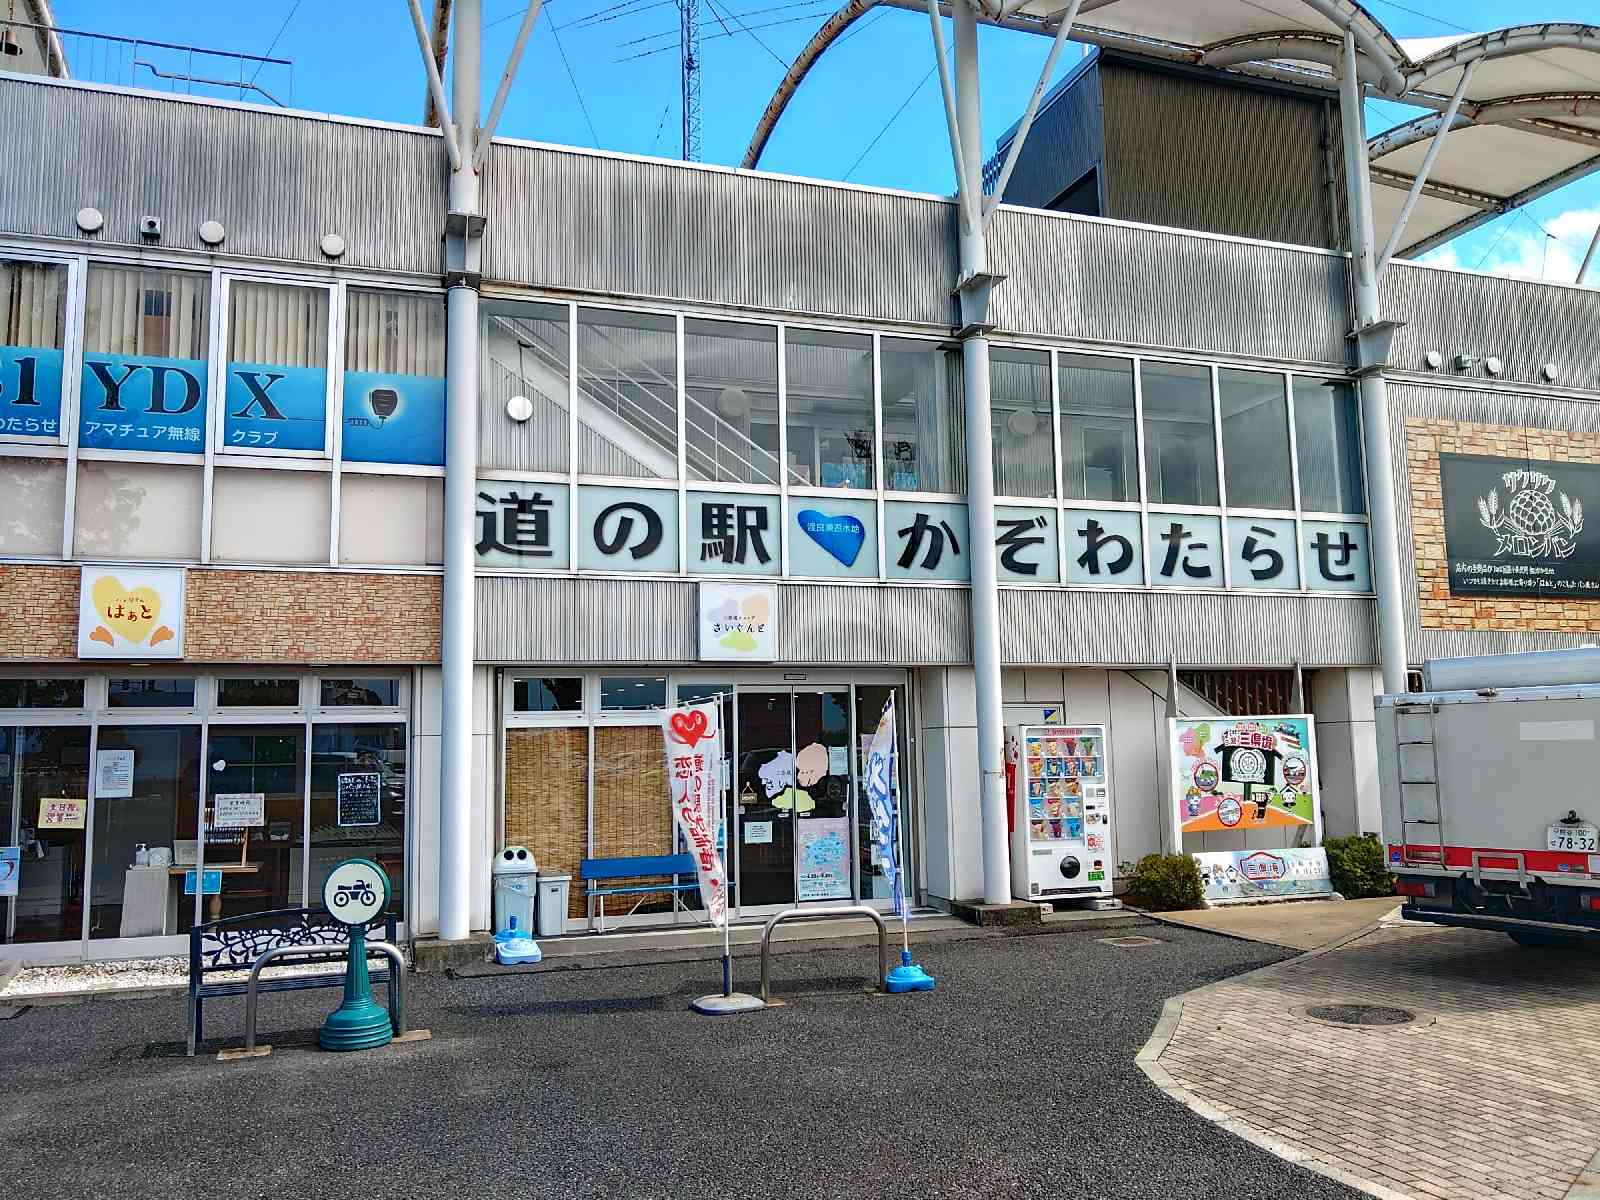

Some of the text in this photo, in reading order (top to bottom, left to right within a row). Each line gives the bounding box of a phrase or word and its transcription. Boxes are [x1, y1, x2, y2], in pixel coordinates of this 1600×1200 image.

[85, 421, 201, 441] アマチュア無線
[232, 430, 279, 445] クラブ
[475, 491, 1358, 581] 道の駅 かぞわたらせ
[107, 604, 152, 622] はぁと
[1558, 836, 1595, 850] 78-32
